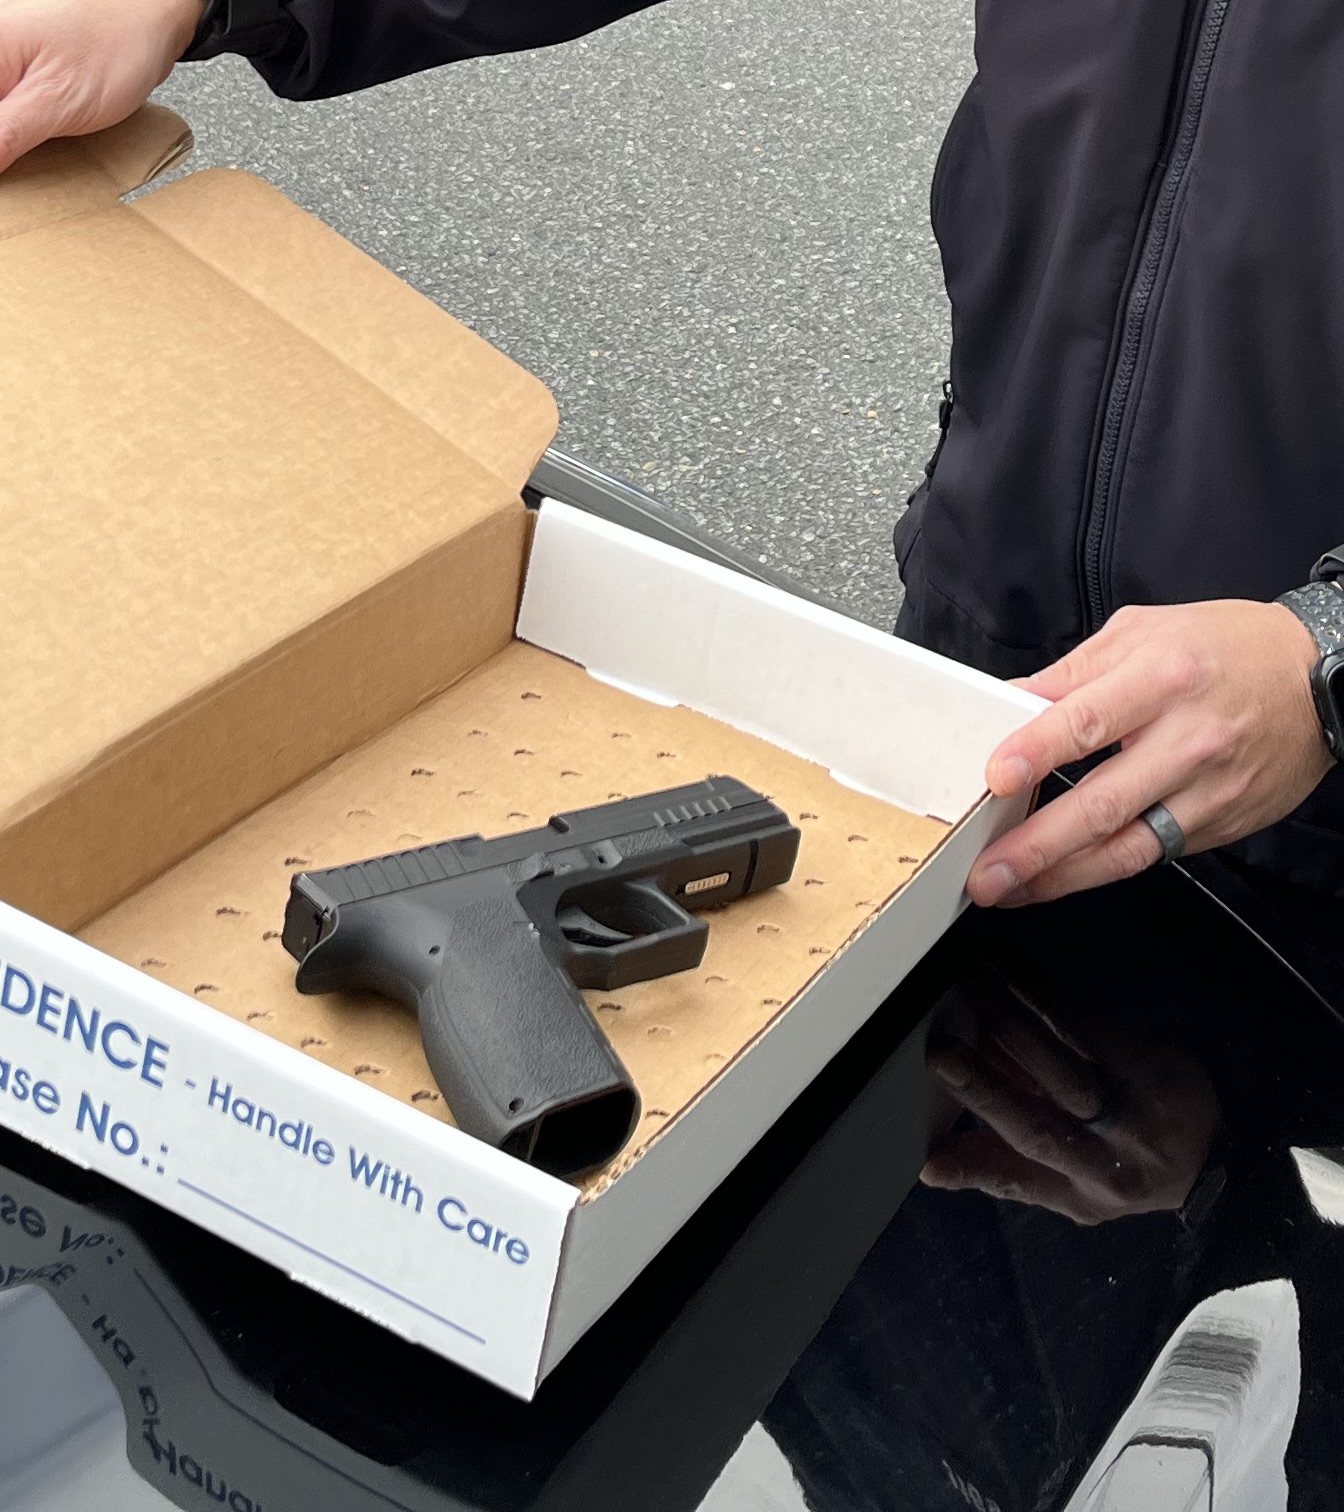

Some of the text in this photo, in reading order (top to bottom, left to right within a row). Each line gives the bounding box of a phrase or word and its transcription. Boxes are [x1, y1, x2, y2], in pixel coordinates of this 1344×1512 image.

[76, 1089, 169, 1176] No.:
[208, 1075, 336, 1166] Handle
[348, 1145, 424, 1214] With
[437, 1195, 531, 1266] Care
